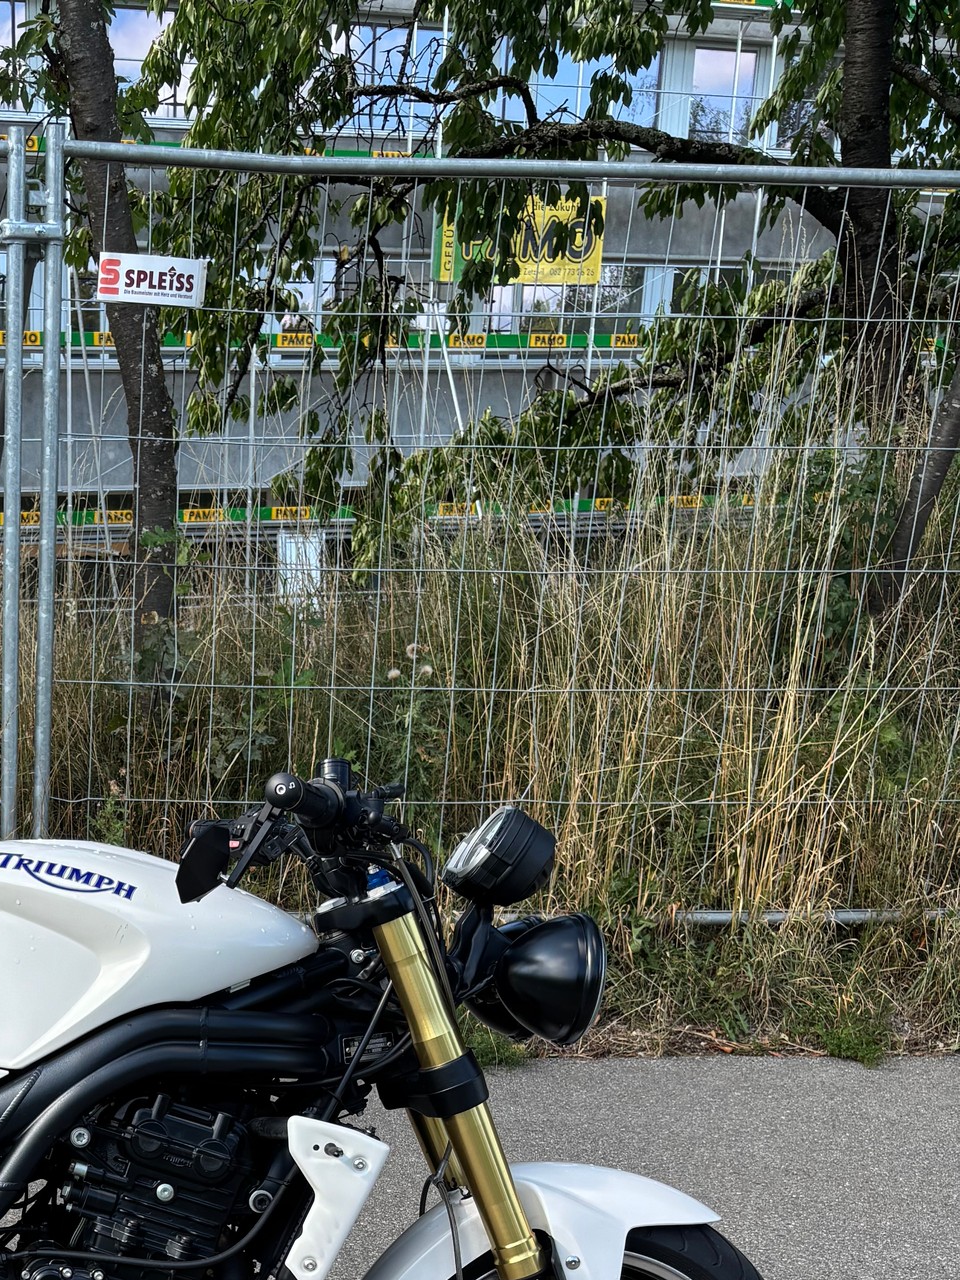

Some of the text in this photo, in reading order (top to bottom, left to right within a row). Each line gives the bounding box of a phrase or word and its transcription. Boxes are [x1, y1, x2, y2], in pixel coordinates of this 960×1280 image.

[444, 222, 454, 271] GERÜ
[282, 334, 313, 346] PAMO
[534, 335, 565, 346] PAMO
[616, 335, 636, 346] PAM
